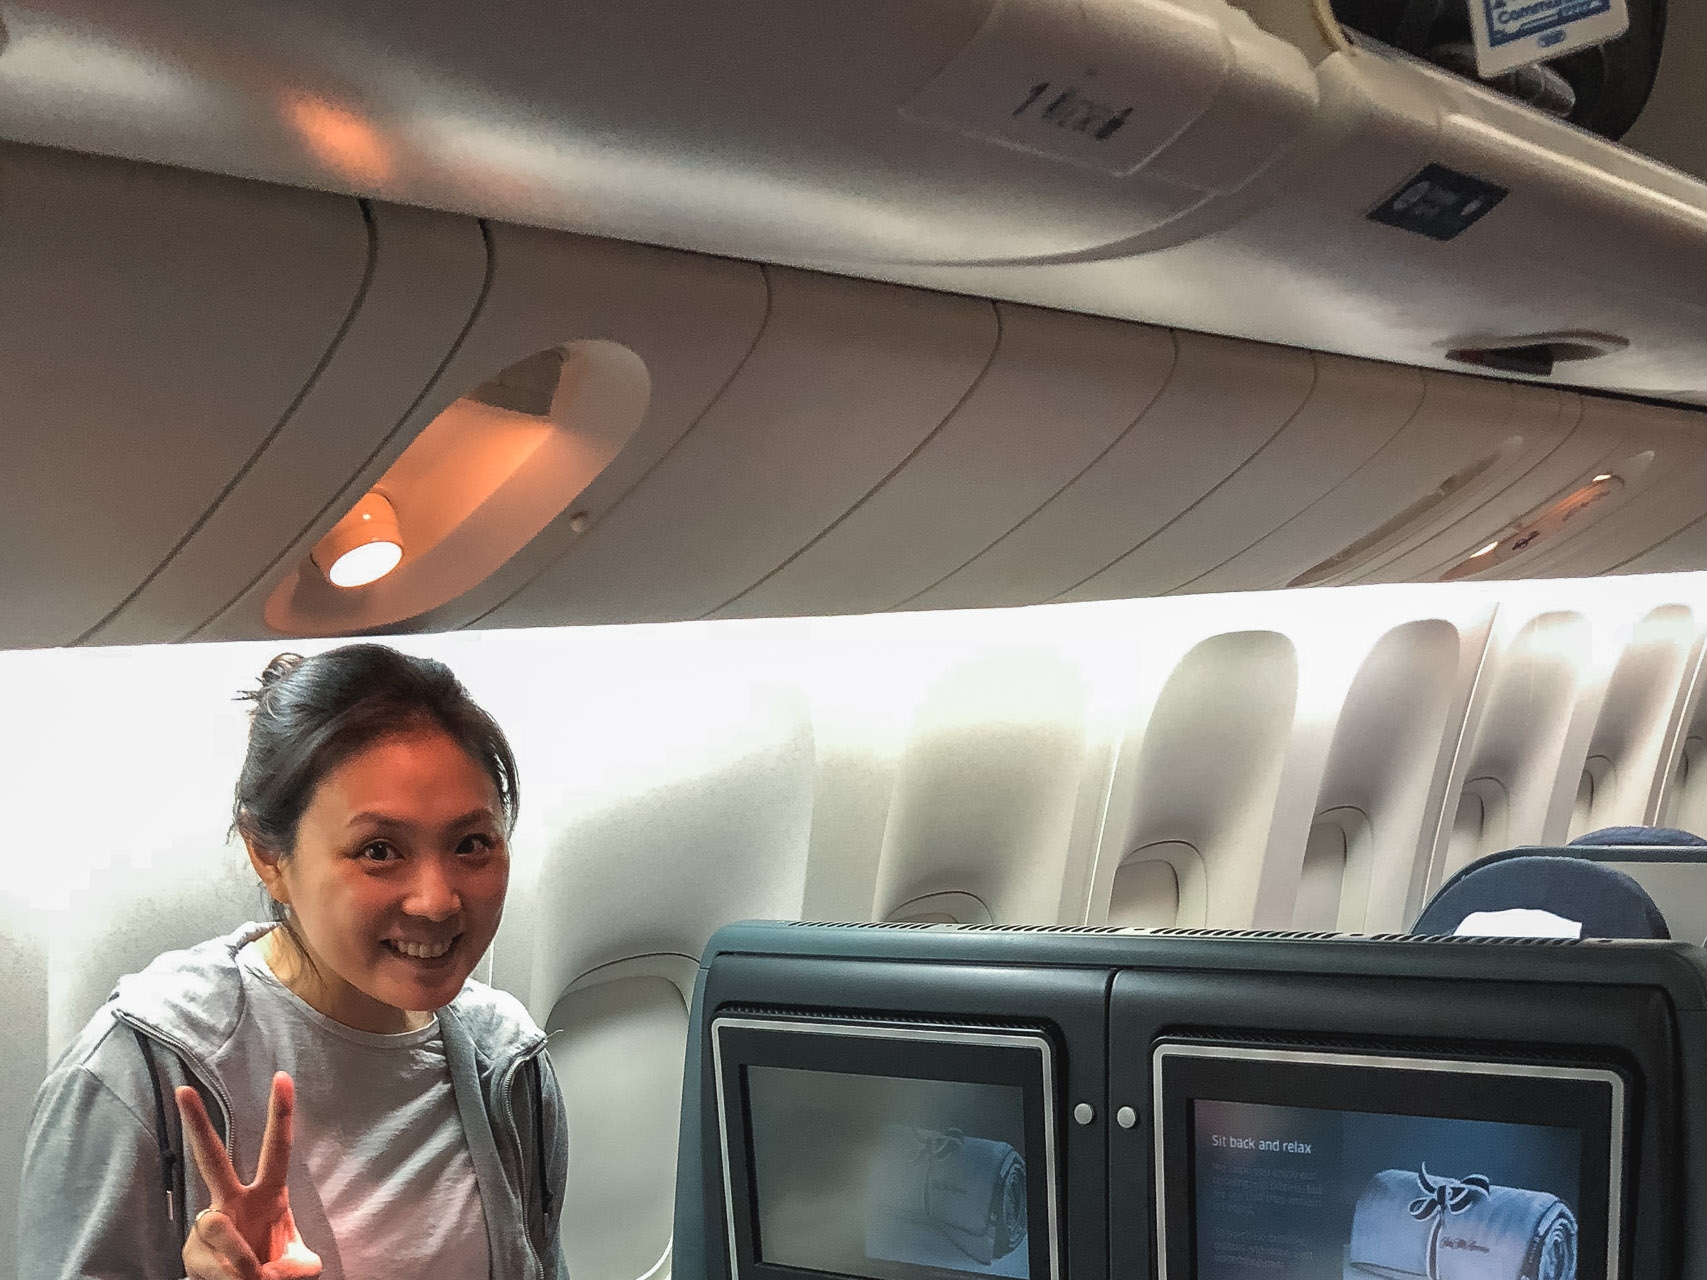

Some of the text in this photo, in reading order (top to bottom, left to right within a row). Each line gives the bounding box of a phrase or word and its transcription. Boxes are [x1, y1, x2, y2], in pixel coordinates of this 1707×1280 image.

[1212, 1134, 1312, 1154] Sit back and relax
